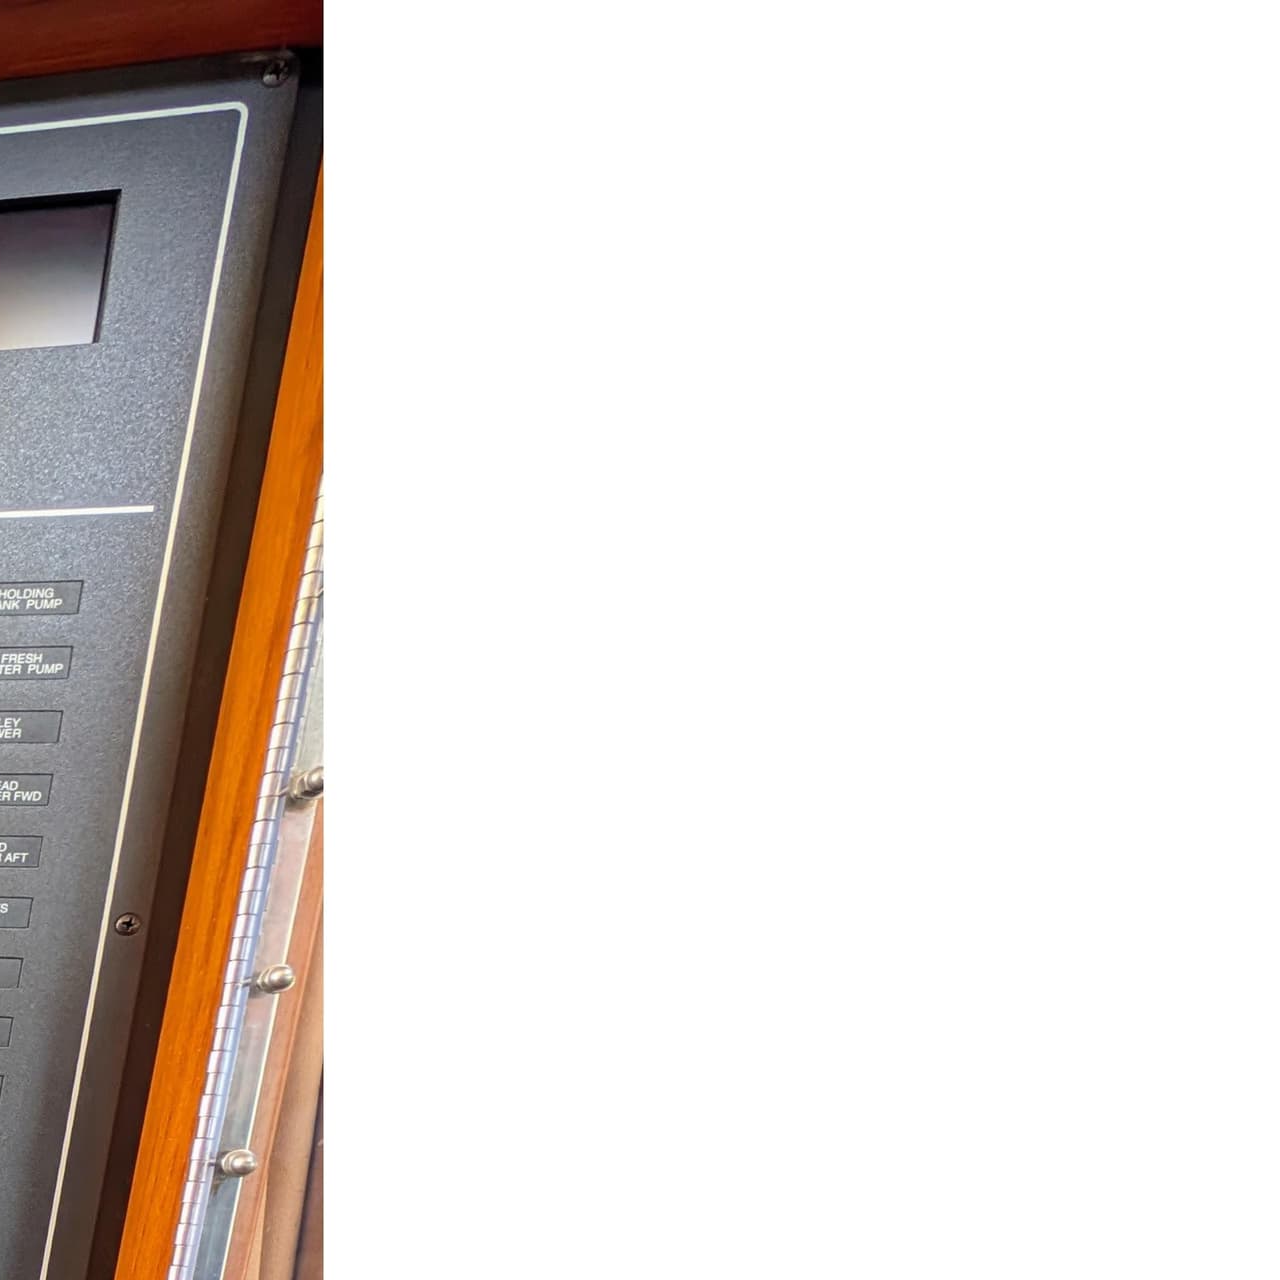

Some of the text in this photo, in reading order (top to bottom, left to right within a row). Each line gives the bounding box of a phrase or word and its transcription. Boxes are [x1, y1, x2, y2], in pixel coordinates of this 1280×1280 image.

[27, 599, 62, 609] PUMP
[1, 654, 42, 664] FRESH
[28, 664, 63, 674] PUMP
[14, 791, 42, 801] FWD
